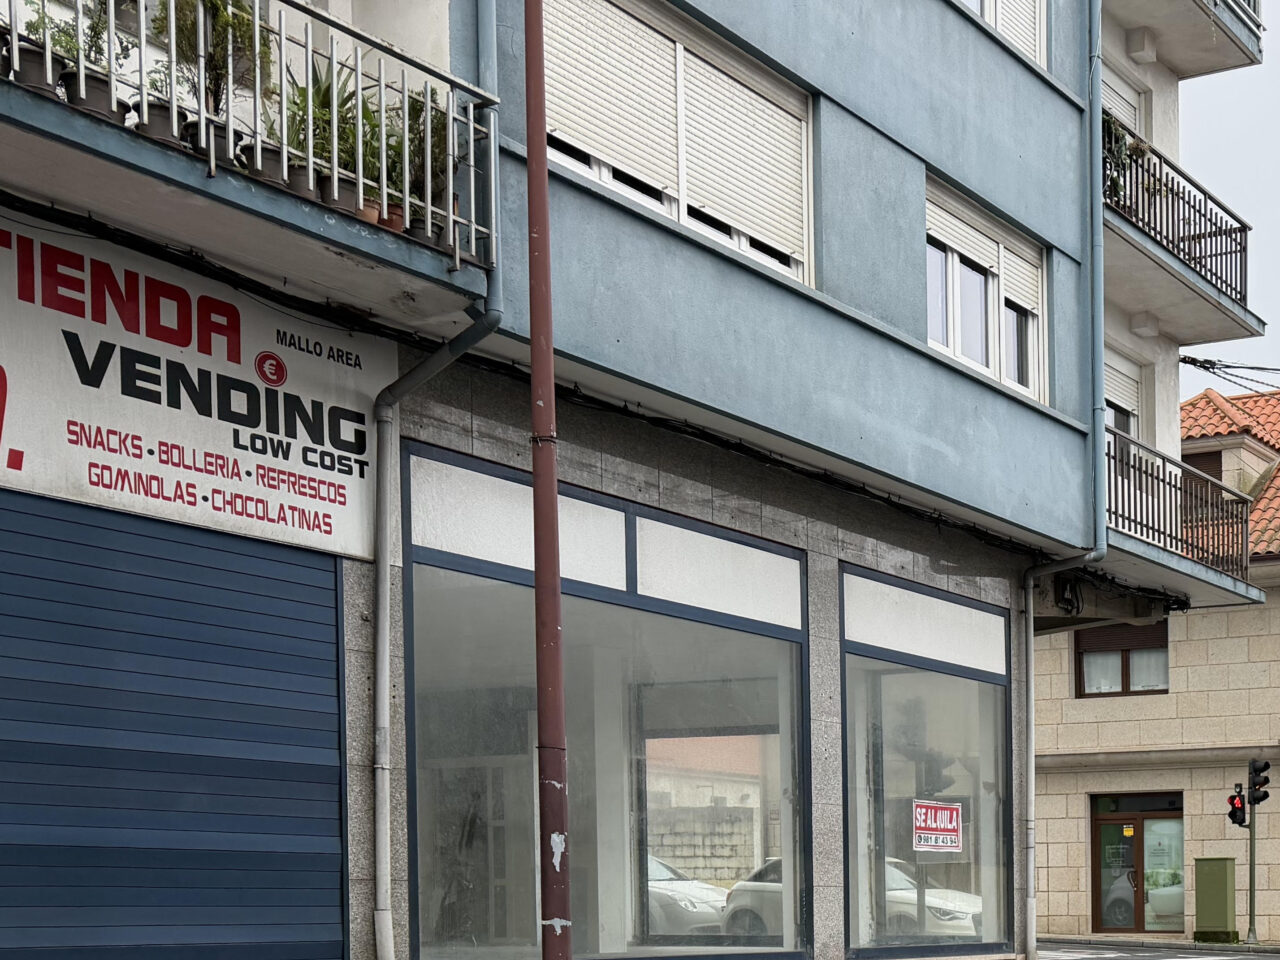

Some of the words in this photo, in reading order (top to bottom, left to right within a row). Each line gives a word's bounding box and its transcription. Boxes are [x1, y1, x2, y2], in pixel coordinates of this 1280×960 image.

[0, 229, 241, 365] IENDA
[276, 329, 323, 358] MALLO
[327, 346, 362, 370] AREA
[61, 329, 367, 455] VENDING
[67, 419, 143, 460] SNACKS
[158, 440, 242, 482] BOLLERIA
[256, 463, 346, 506] REFRESCOS
[233, 428, 291, 461] LOW
[302, 446, 369, 479] COST
[88, 462, 197, 507] GOMINOLAS
[211, 488, 332, 536] CHOCOLATINAS
[916, 807, 926, 827] SE
